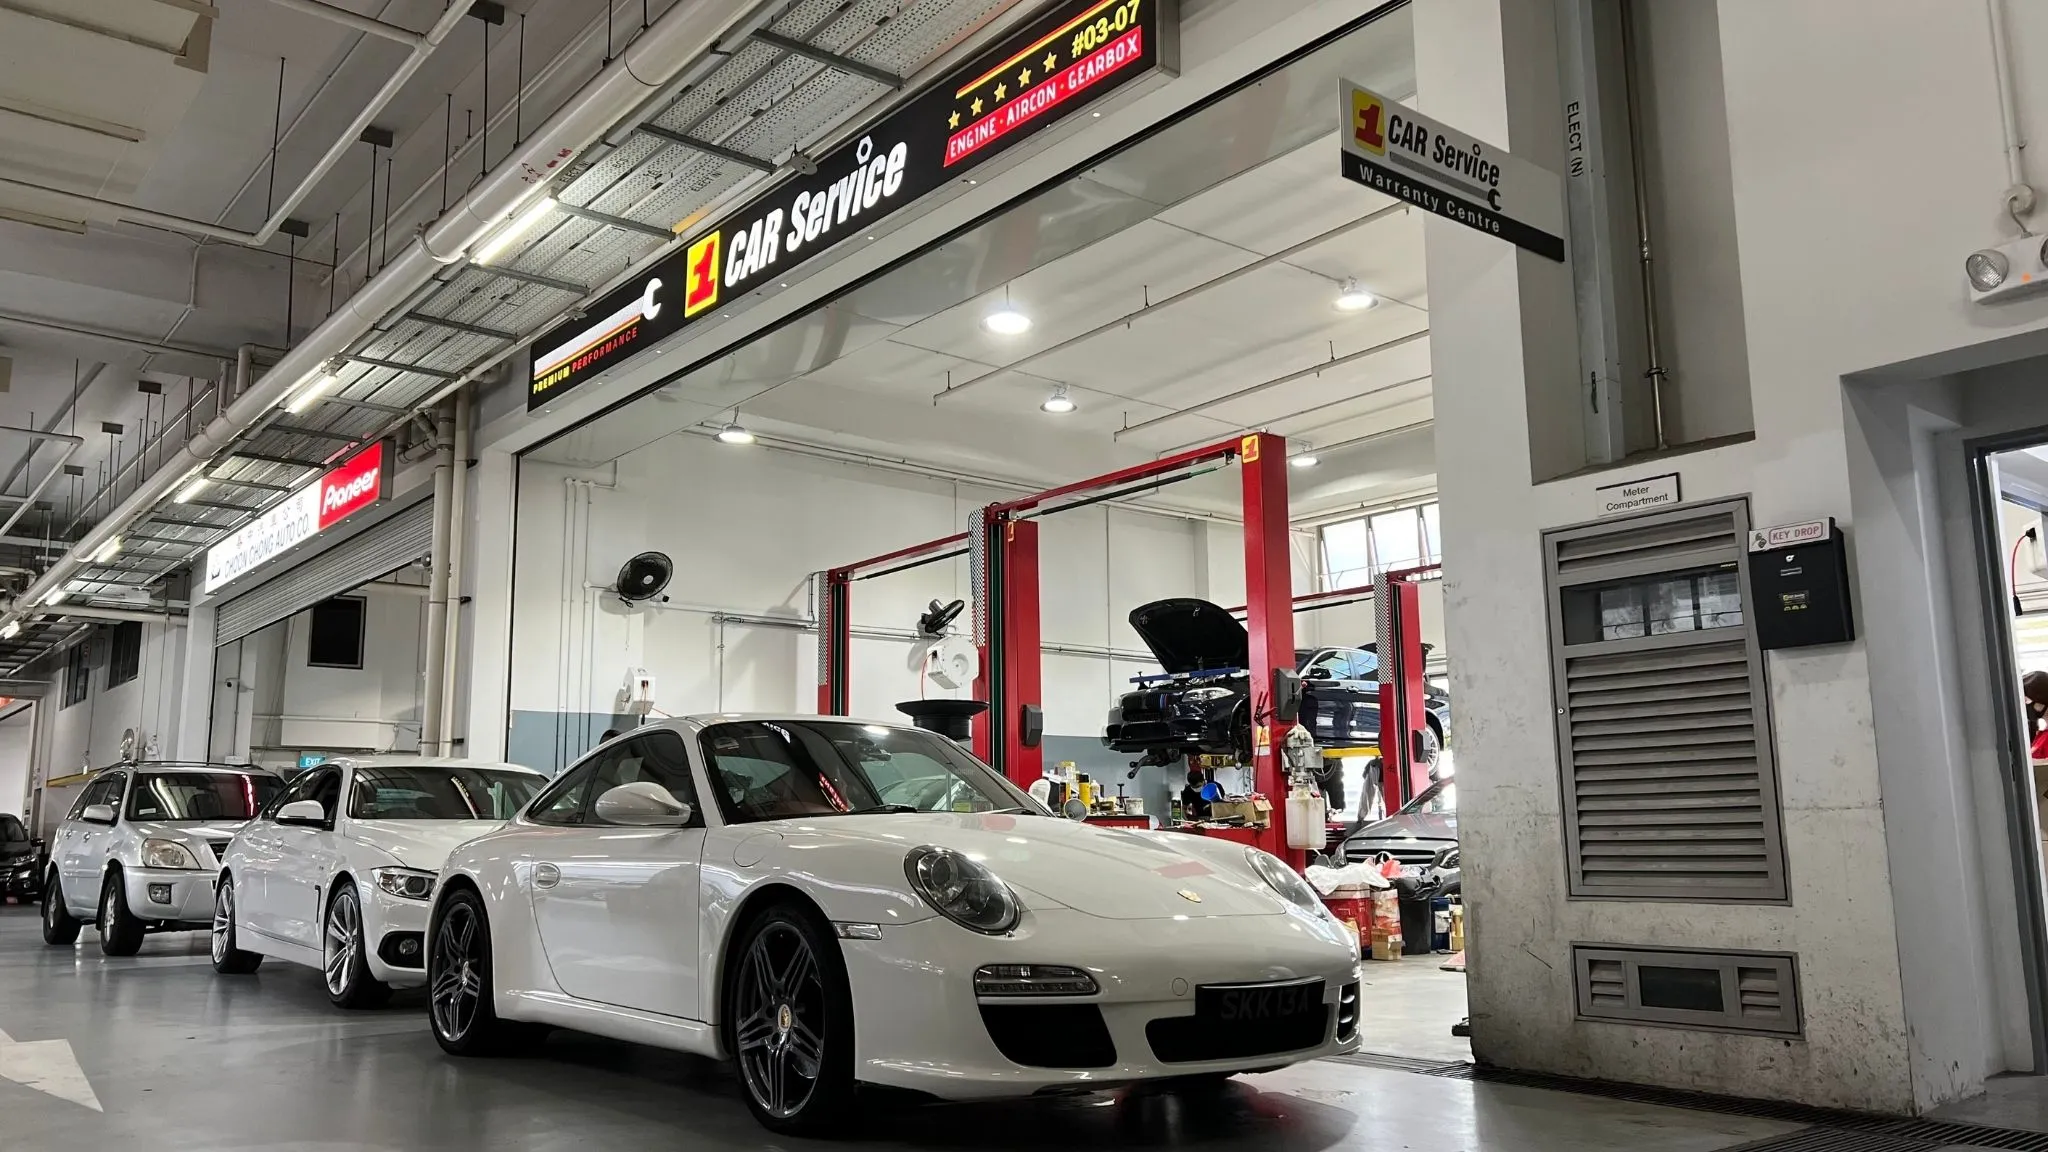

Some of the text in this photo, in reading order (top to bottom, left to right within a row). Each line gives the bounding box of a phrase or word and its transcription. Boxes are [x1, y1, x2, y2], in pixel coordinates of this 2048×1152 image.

[1071, 0, 1141, 58] #03-07
[950, 33, 1138, 158] ENGINE AIRCON GEARBOX
[1355, 104, 1500, 187] 1 CAR Service
[1567, 101, 1584, 178] ELECT (N)
[687, 136, 908, 309] 1 CAR Service
[1359, 164, 1500, 233] Warranty Centre
[533, 326, 638, 394] PREMIUM PERFORMANCE
[321, 467, 379, 516] Pioneer
[1606, 493, 1668, 511] Compartment
[1622, 485, 1649, 498] Meter
[275, 521, 295, 548] AUTO
[1772, 525, 1820, 541] KEY DROP
[305, 757, 320, 766] EXIT
